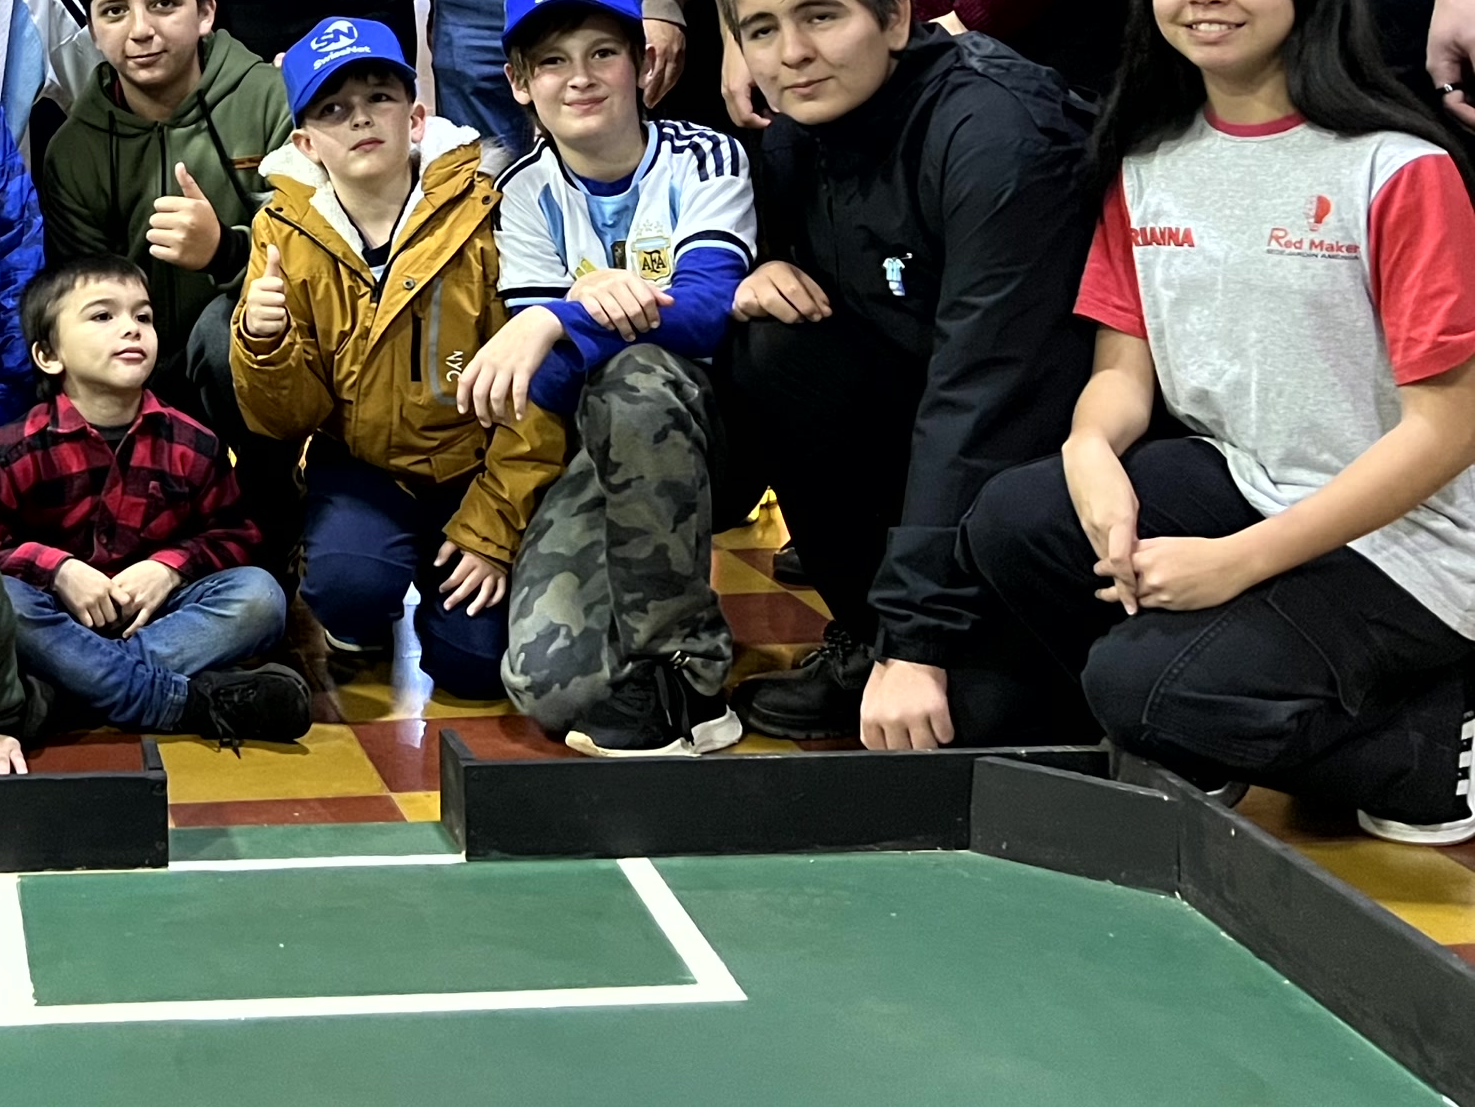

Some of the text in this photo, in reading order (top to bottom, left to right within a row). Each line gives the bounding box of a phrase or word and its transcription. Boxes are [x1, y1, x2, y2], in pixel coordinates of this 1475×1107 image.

[1267, 227, 1360, 254] Red Maker
[445, 350, 464, 382] NYC
